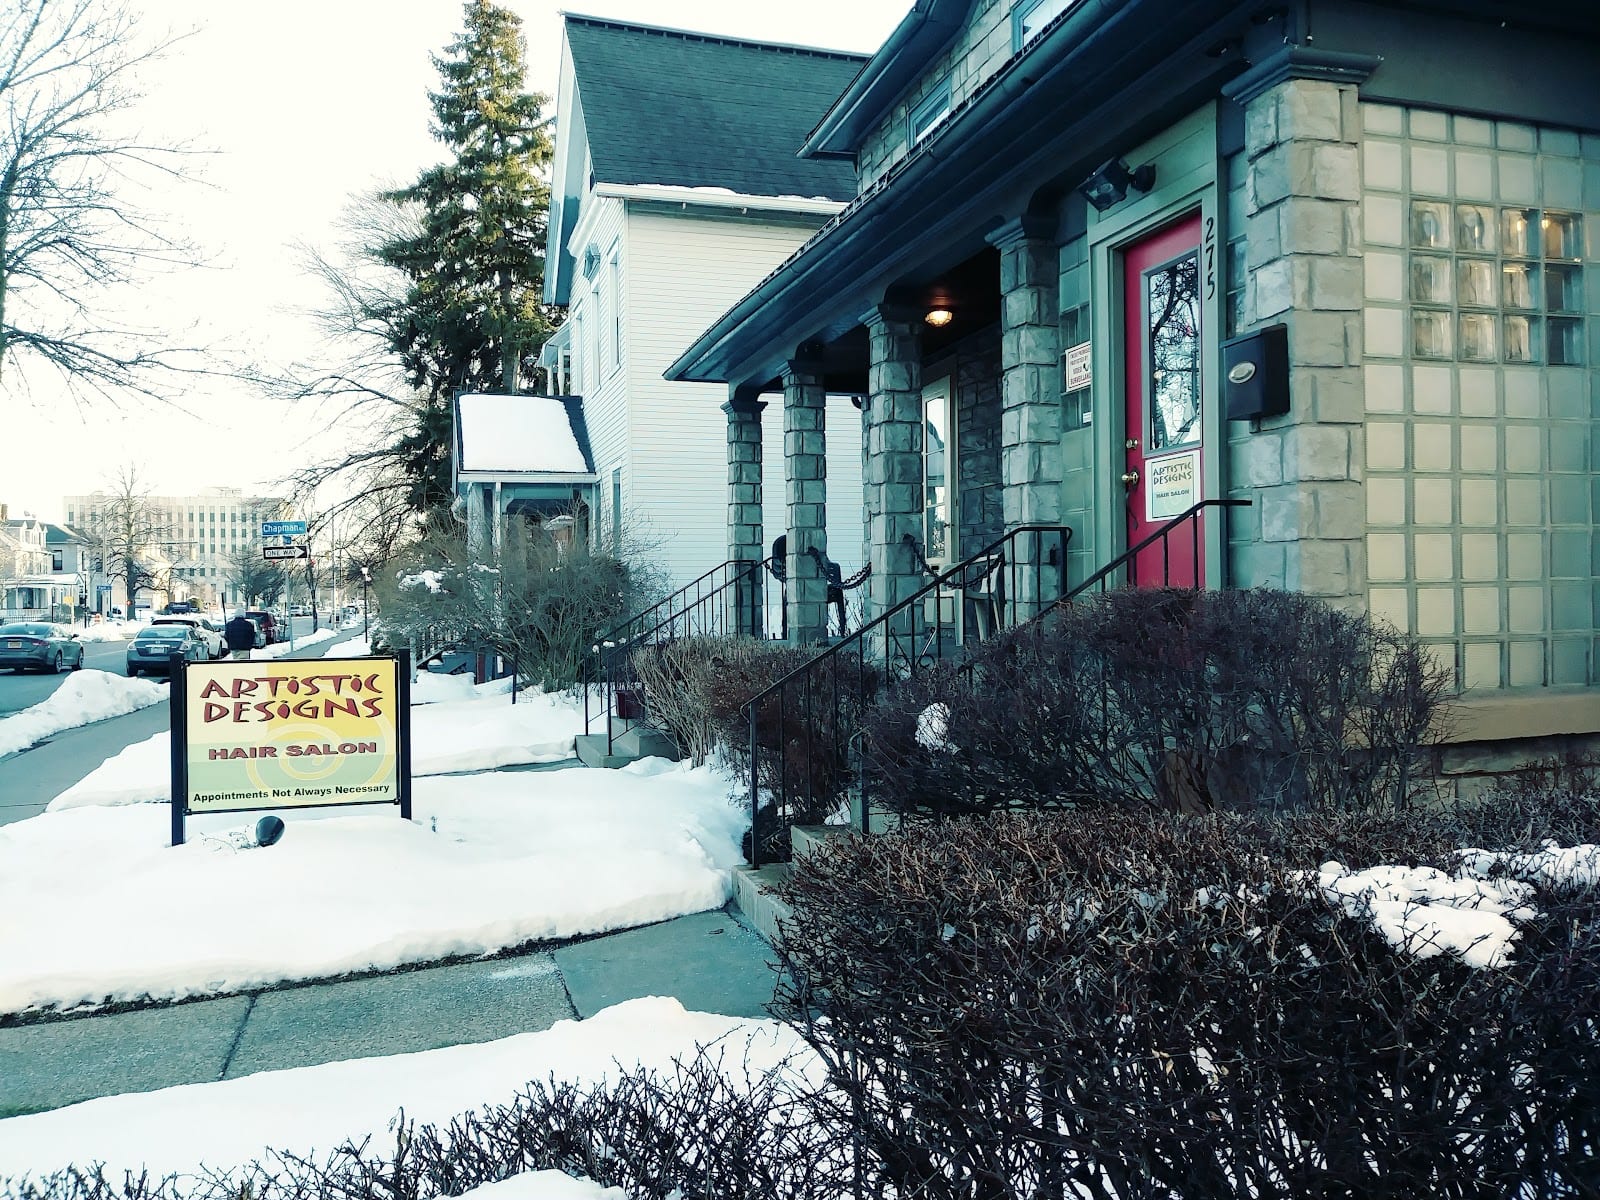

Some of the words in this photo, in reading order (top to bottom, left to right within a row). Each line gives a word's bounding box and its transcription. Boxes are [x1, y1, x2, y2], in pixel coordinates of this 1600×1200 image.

[1205, 216, 1215, 300] 275
[1154, 462, 1192, 476] ARTISTIC
[1154, 472, 1192, 485] DESIGNS
[263, 524, 298, 533] Chapman
[200, 674, 384, 699] ARTISTIC
[204, 697, 383, 723] DESIGNS
[208, 746, 278, 760] HAIR
[285, 742, 377, 757] SALON
[193, 790, 269, 803] Appointments
[272, 788, 291, 798] Not
[294, 787, 332, 797] Always
[335, 784, 390, 794] Necessary
